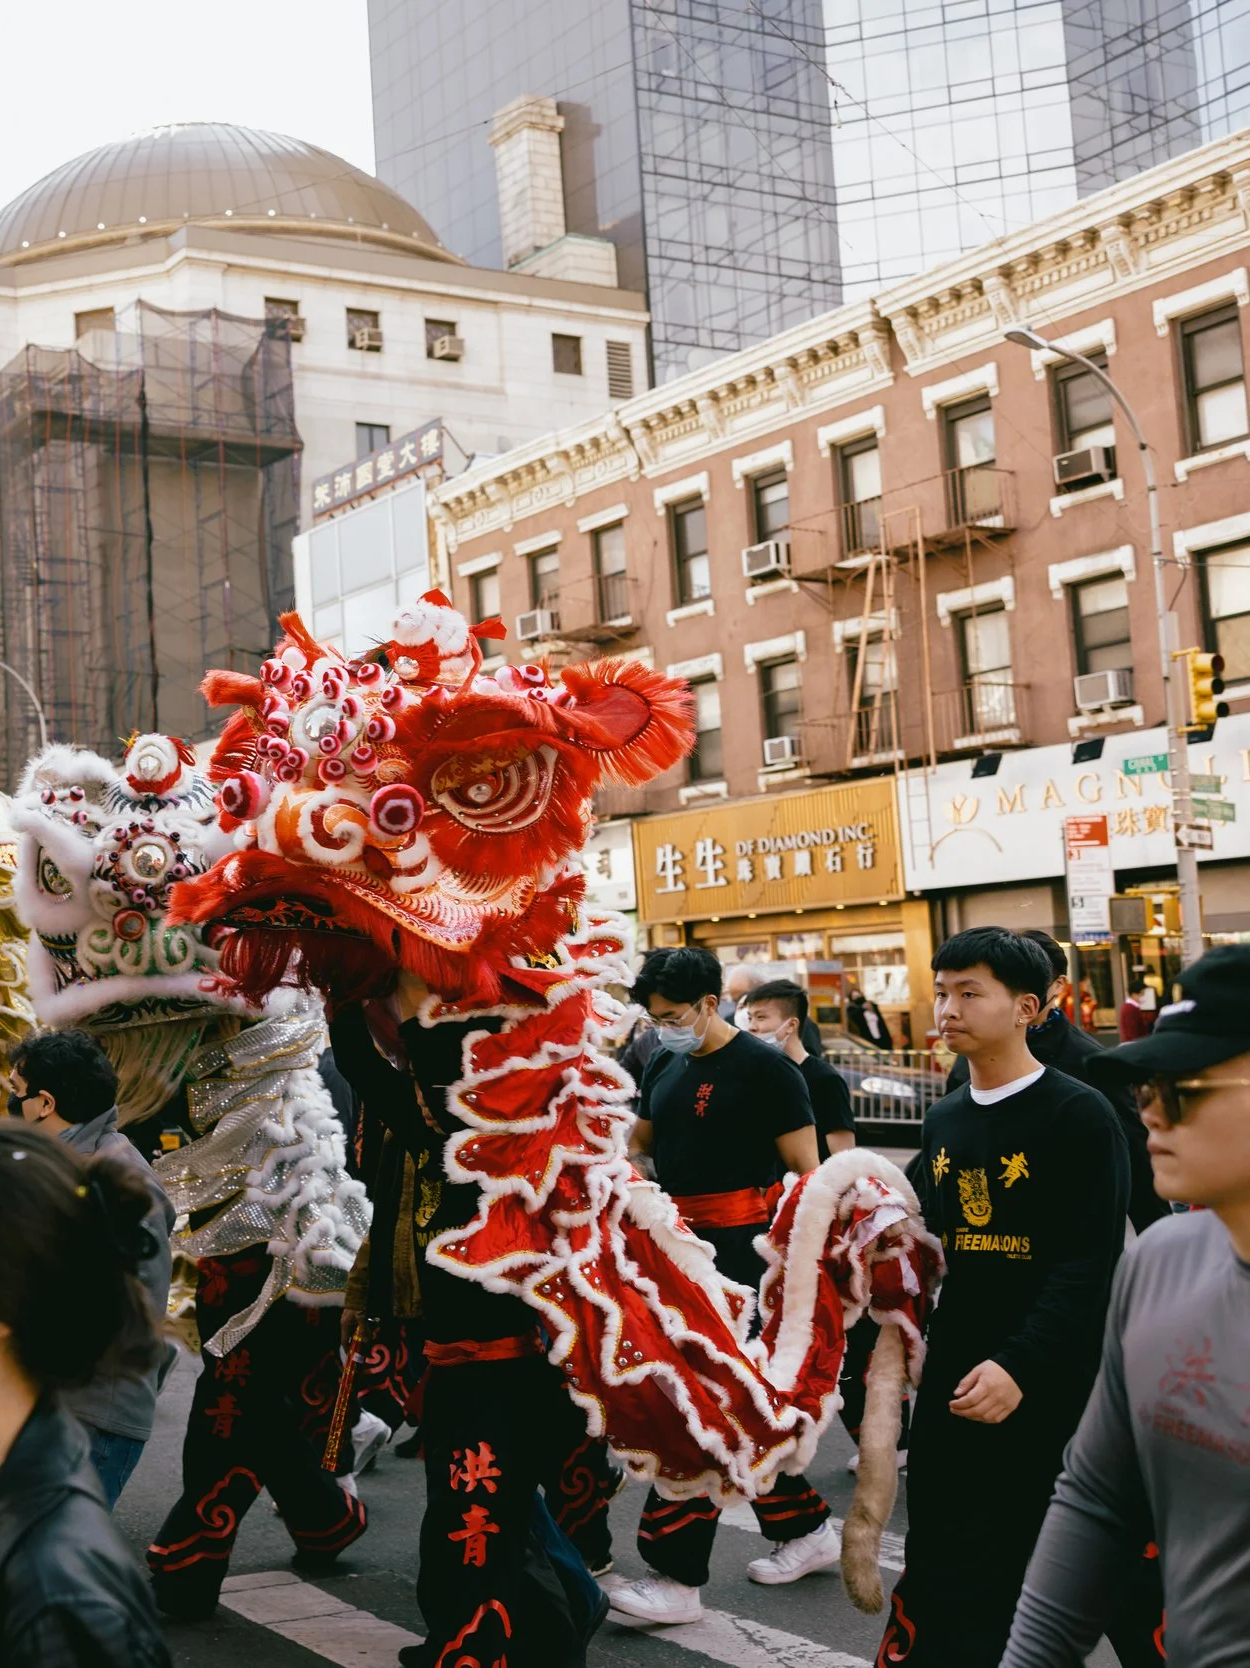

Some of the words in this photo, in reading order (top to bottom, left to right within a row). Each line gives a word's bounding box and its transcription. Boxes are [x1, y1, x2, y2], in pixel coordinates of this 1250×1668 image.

[656, 837, 727, 894] 生生
[758, 828, 836, 854] DIAMOND
[838, 822, 874, 842] INC.
[448, 1441, 502, 1566] 洪青
